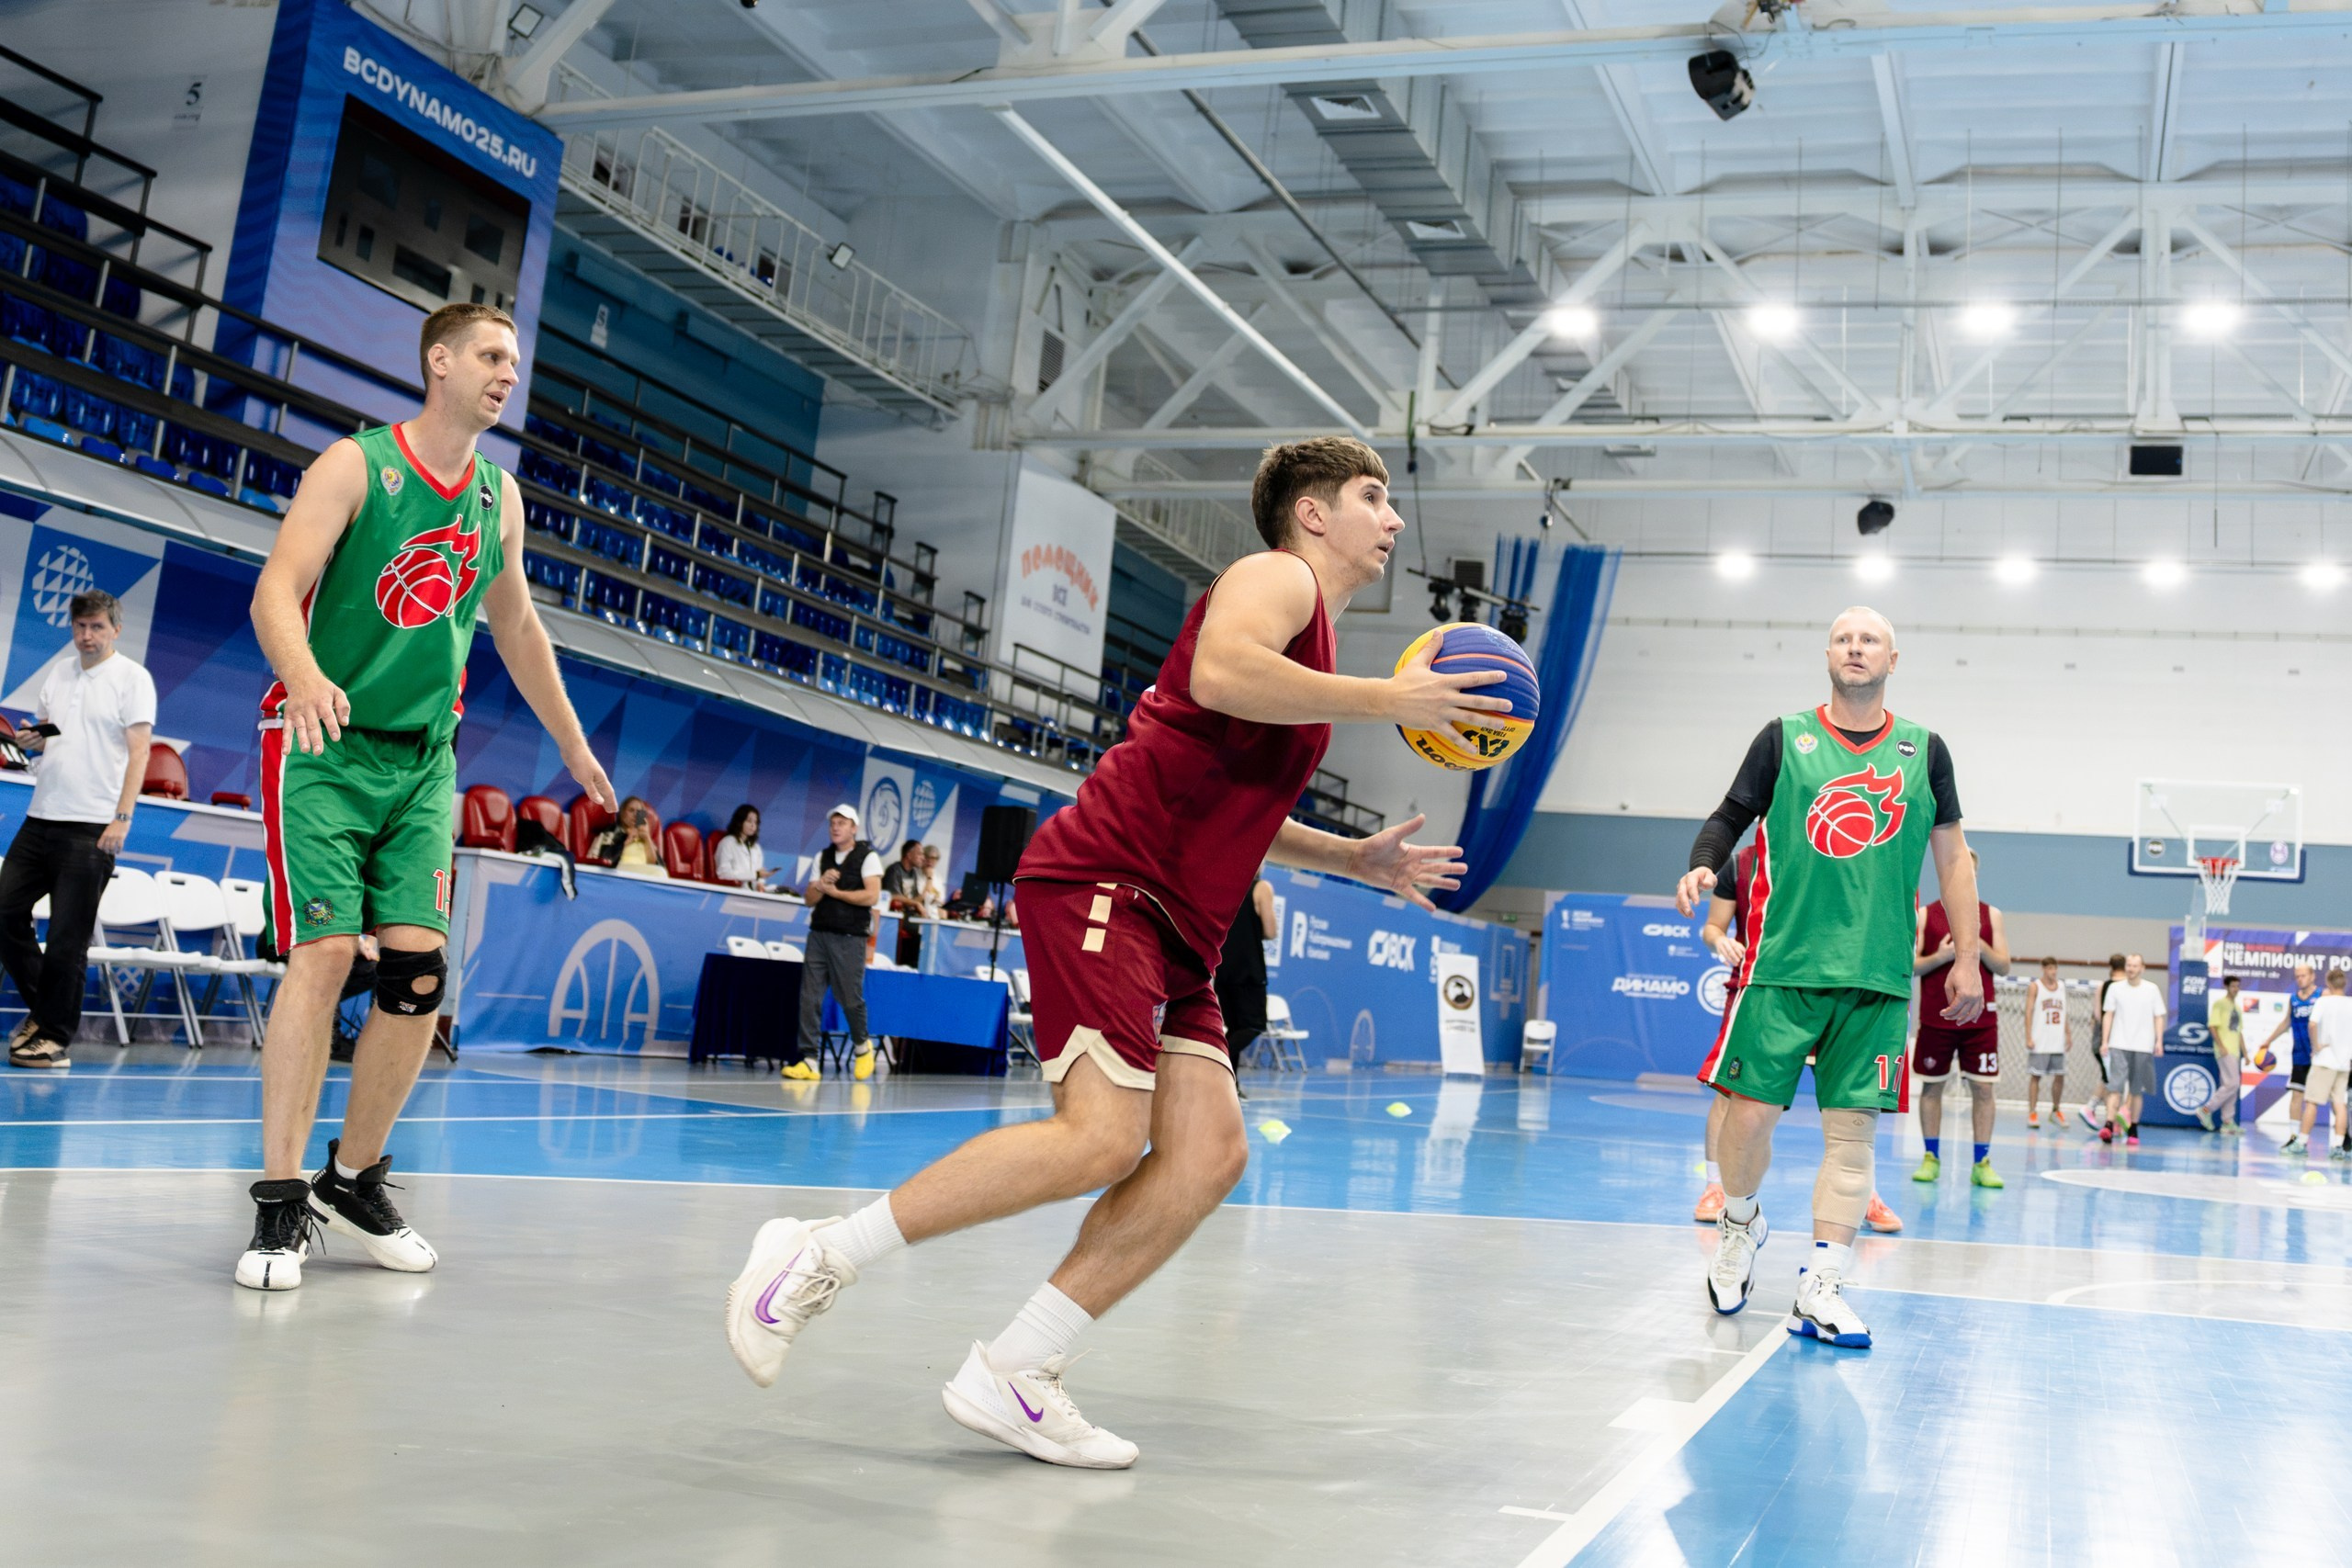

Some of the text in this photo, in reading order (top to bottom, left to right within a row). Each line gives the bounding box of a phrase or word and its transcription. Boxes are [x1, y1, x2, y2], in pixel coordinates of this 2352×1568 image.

[186, 82, 201, 106] 5
[344, 46, 537, 178] BCDYNAMO25.RU
[2223, 950, 2352, 972] ЧЕМПИОНАТ РО
[1611, 977, 1690, 996] ДИНАМО
[2045, 1011, 2060, 1024] 12
[1874, 1055, 1905, 1092] 11
[1978, 1052, 1998, 1073] 13
